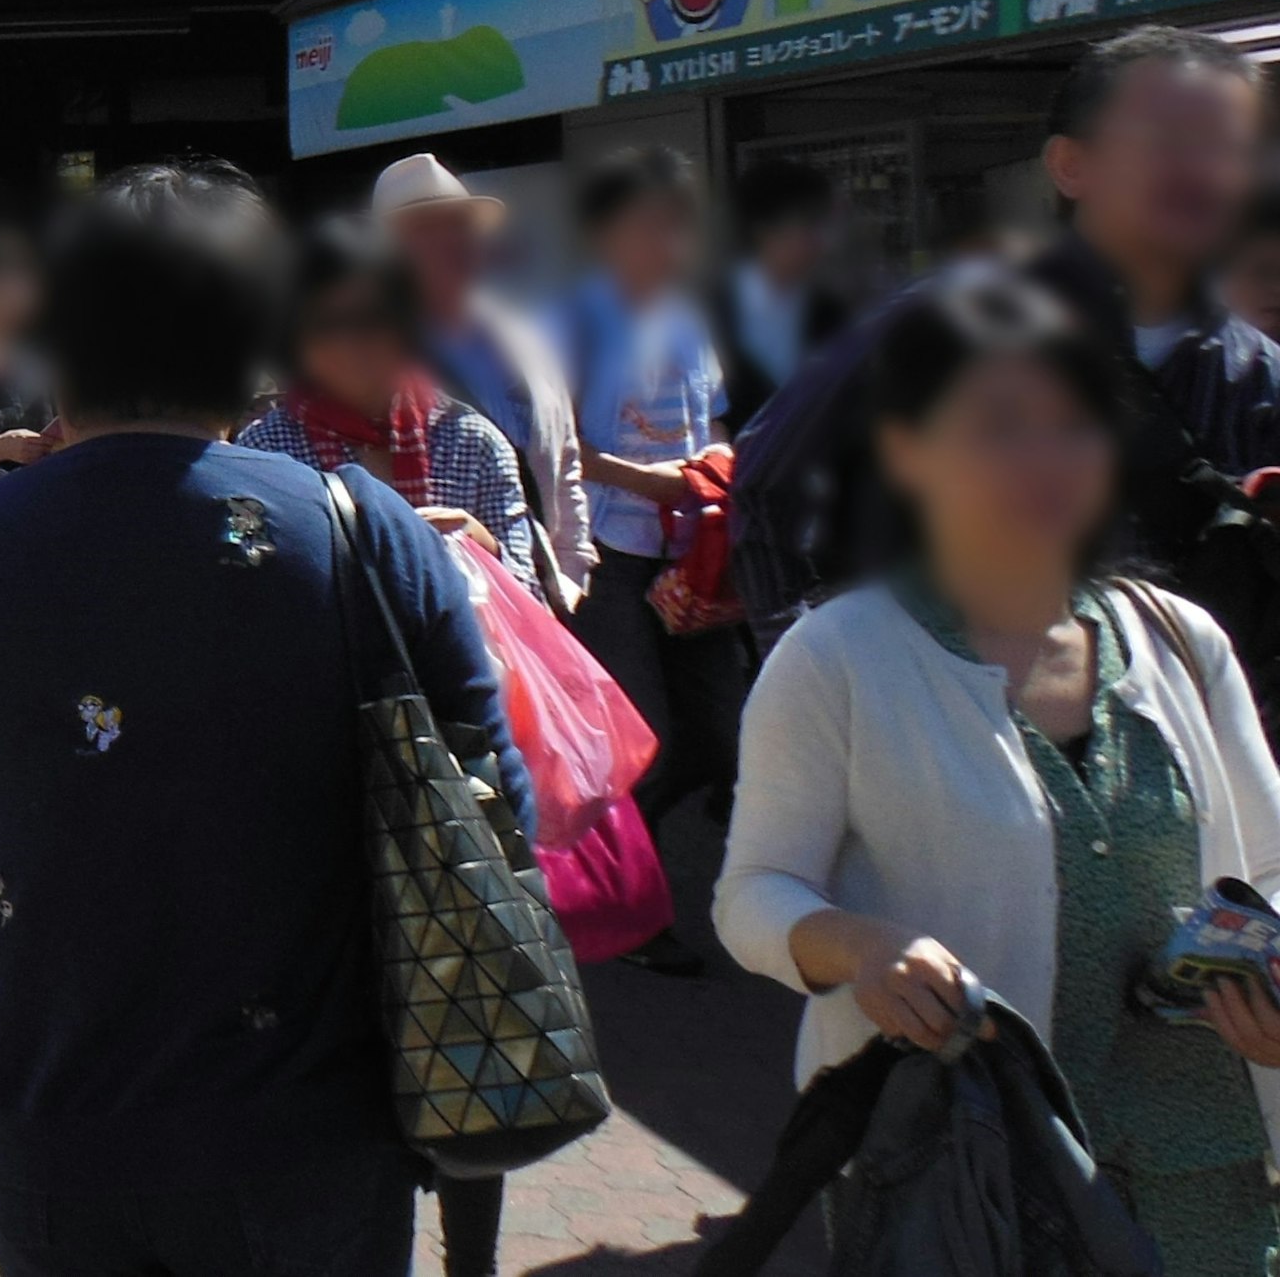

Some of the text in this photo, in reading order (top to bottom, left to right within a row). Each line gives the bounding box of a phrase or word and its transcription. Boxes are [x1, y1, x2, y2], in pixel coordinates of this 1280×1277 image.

[746, 24, 882, 67] ミルクチョコレート
